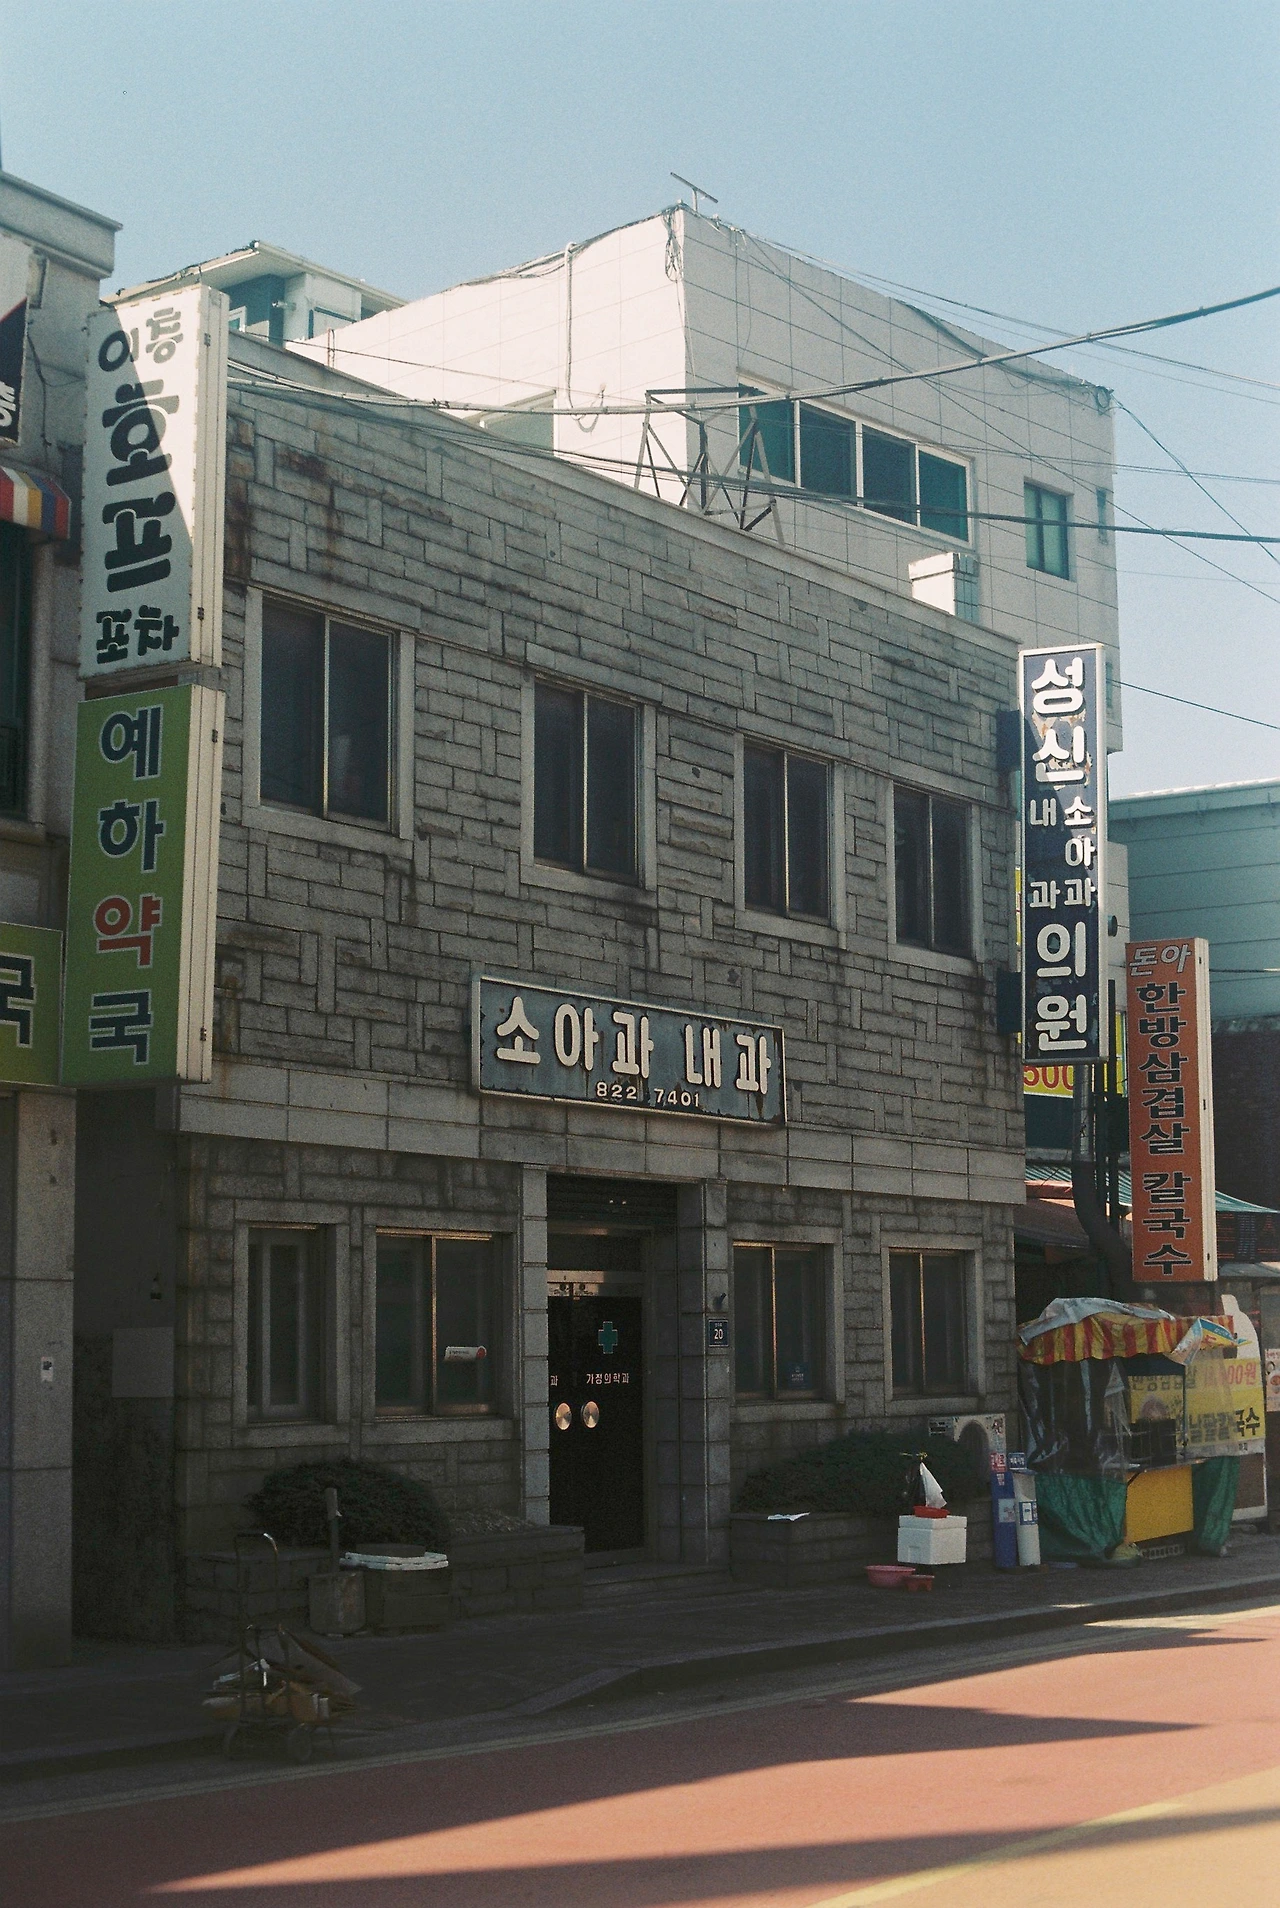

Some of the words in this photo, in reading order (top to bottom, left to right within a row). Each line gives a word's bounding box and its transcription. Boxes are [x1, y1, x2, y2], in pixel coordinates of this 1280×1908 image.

[102, 378, 180, 593] 호프
[97, 604, 180, 664] 포차
[1030, 658, 1088, 783] 성신
[88, 704, 167, 1066] 예하약국
[1063, 795, 1098, 908] 소아과
[1035, 921, 1088, 1052] 의원
[1130, 944, 1192, 977] 돈아
[496, 996, 655, 1079] 소아과
[685, 1023, 773, 1095] 내과
[596, 1081, 638, 1101] 822
[654, 1088, 701, 1108] 7401
[1135, 981, 1191, 1155] 한방삼겹살
[1142, 1171, 1193, 1276] 칼국수
[586, 1373, 630, 1386] 가정의학과
[714, 1328, 724, 1340] 20
